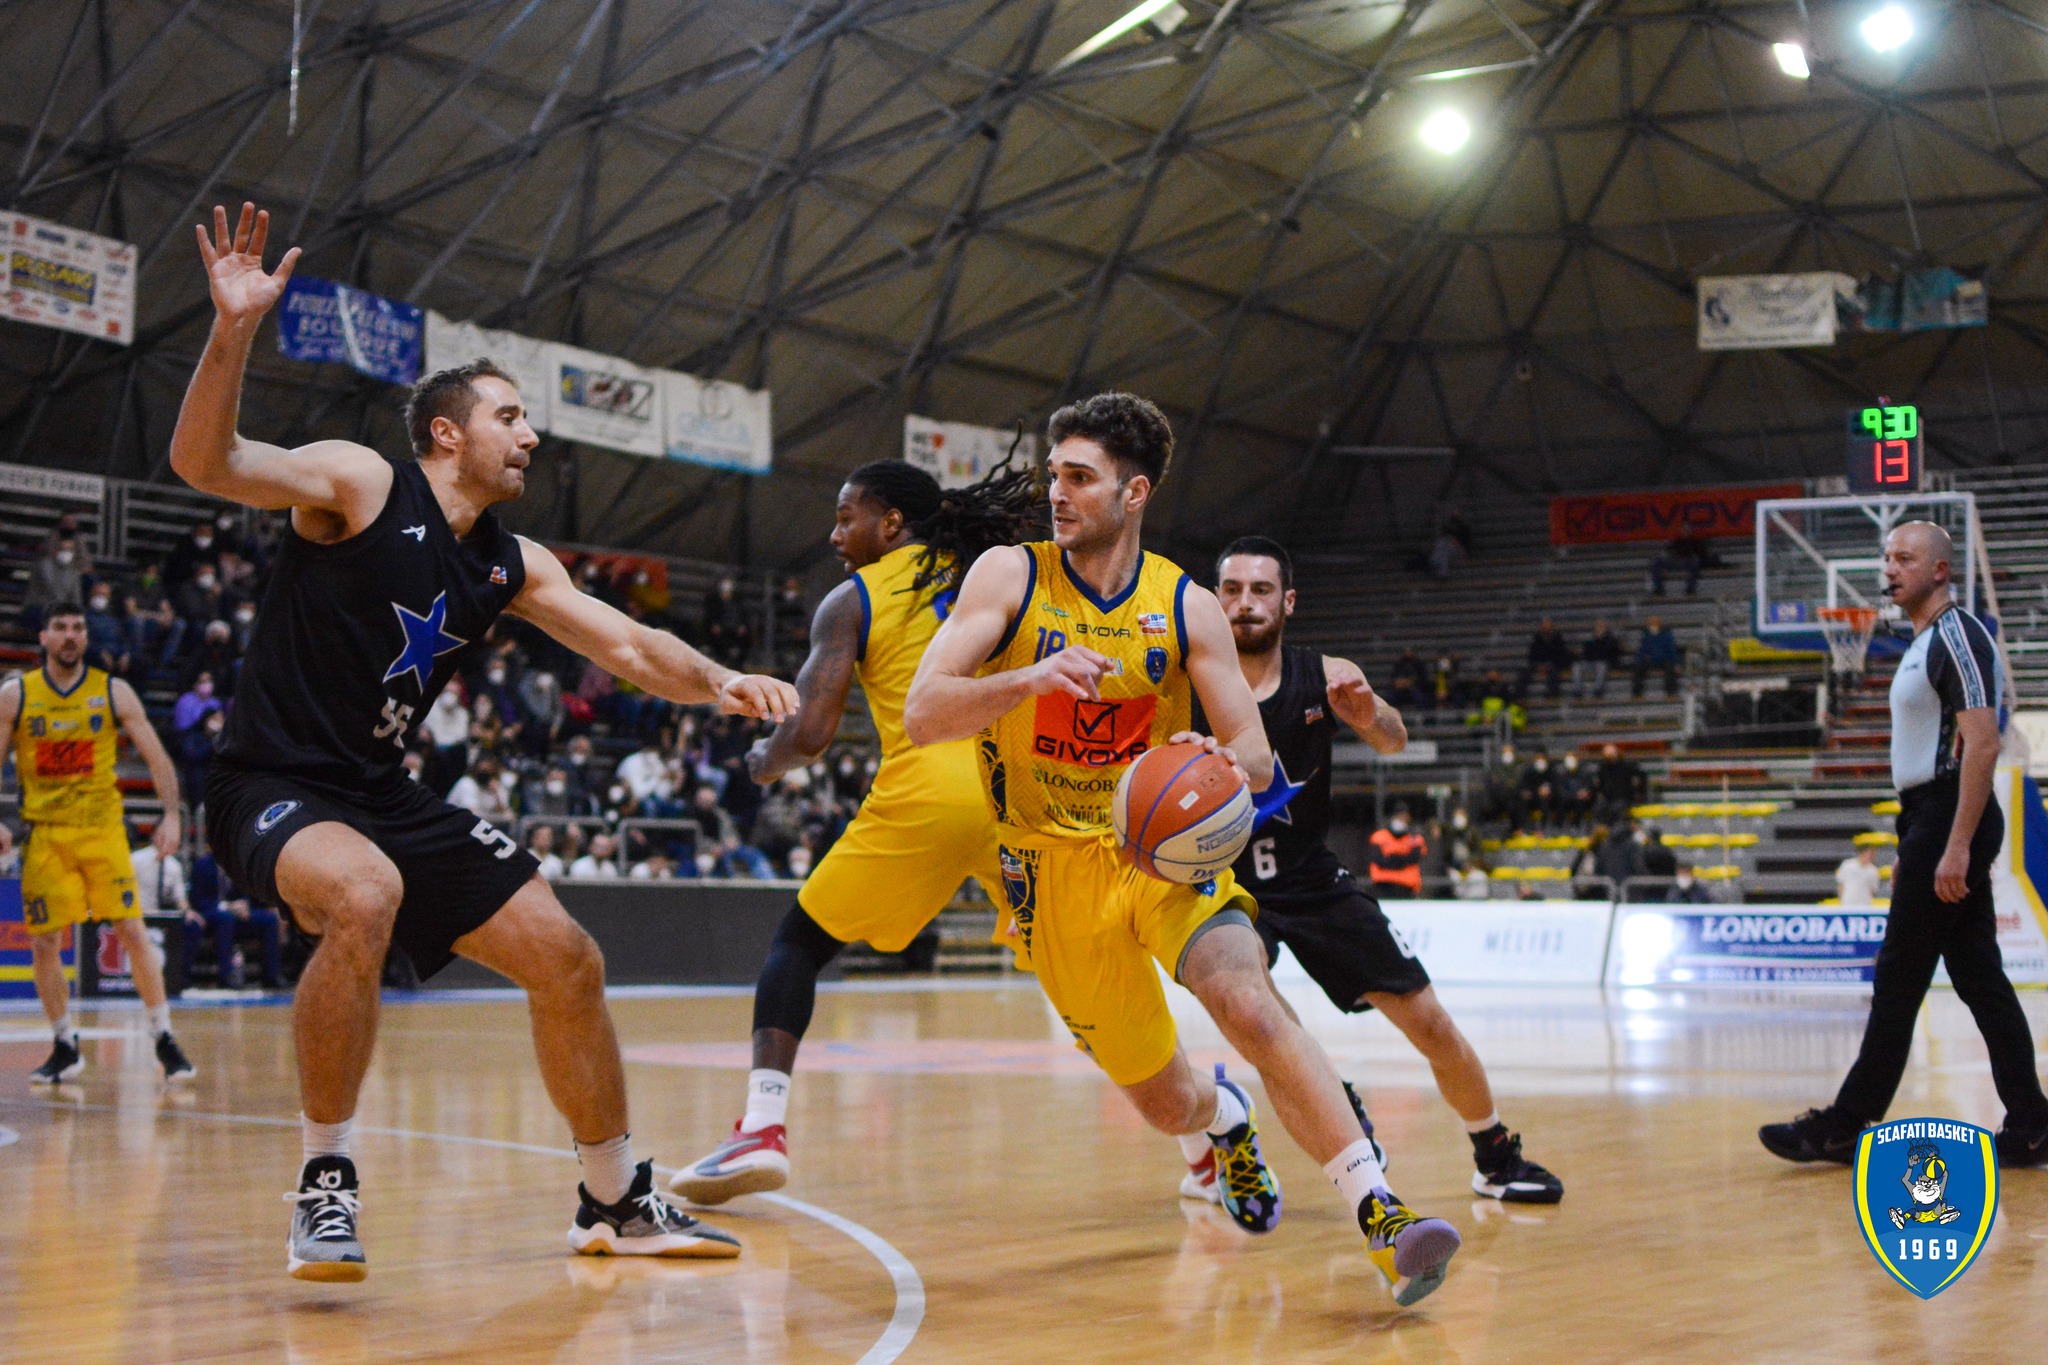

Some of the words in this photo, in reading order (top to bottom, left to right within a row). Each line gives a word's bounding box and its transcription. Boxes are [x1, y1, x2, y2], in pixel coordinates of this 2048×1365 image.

[1863, 405, 1917, 440] 930
[1874, 440, 1909, 483] 13
[1604, 500, 1754, 533] GIVOV
[1076, 623, 1131, 638] GVOVA
[470, 818, 517, 859] 5
[1252, 837, 1277, 880] 6
